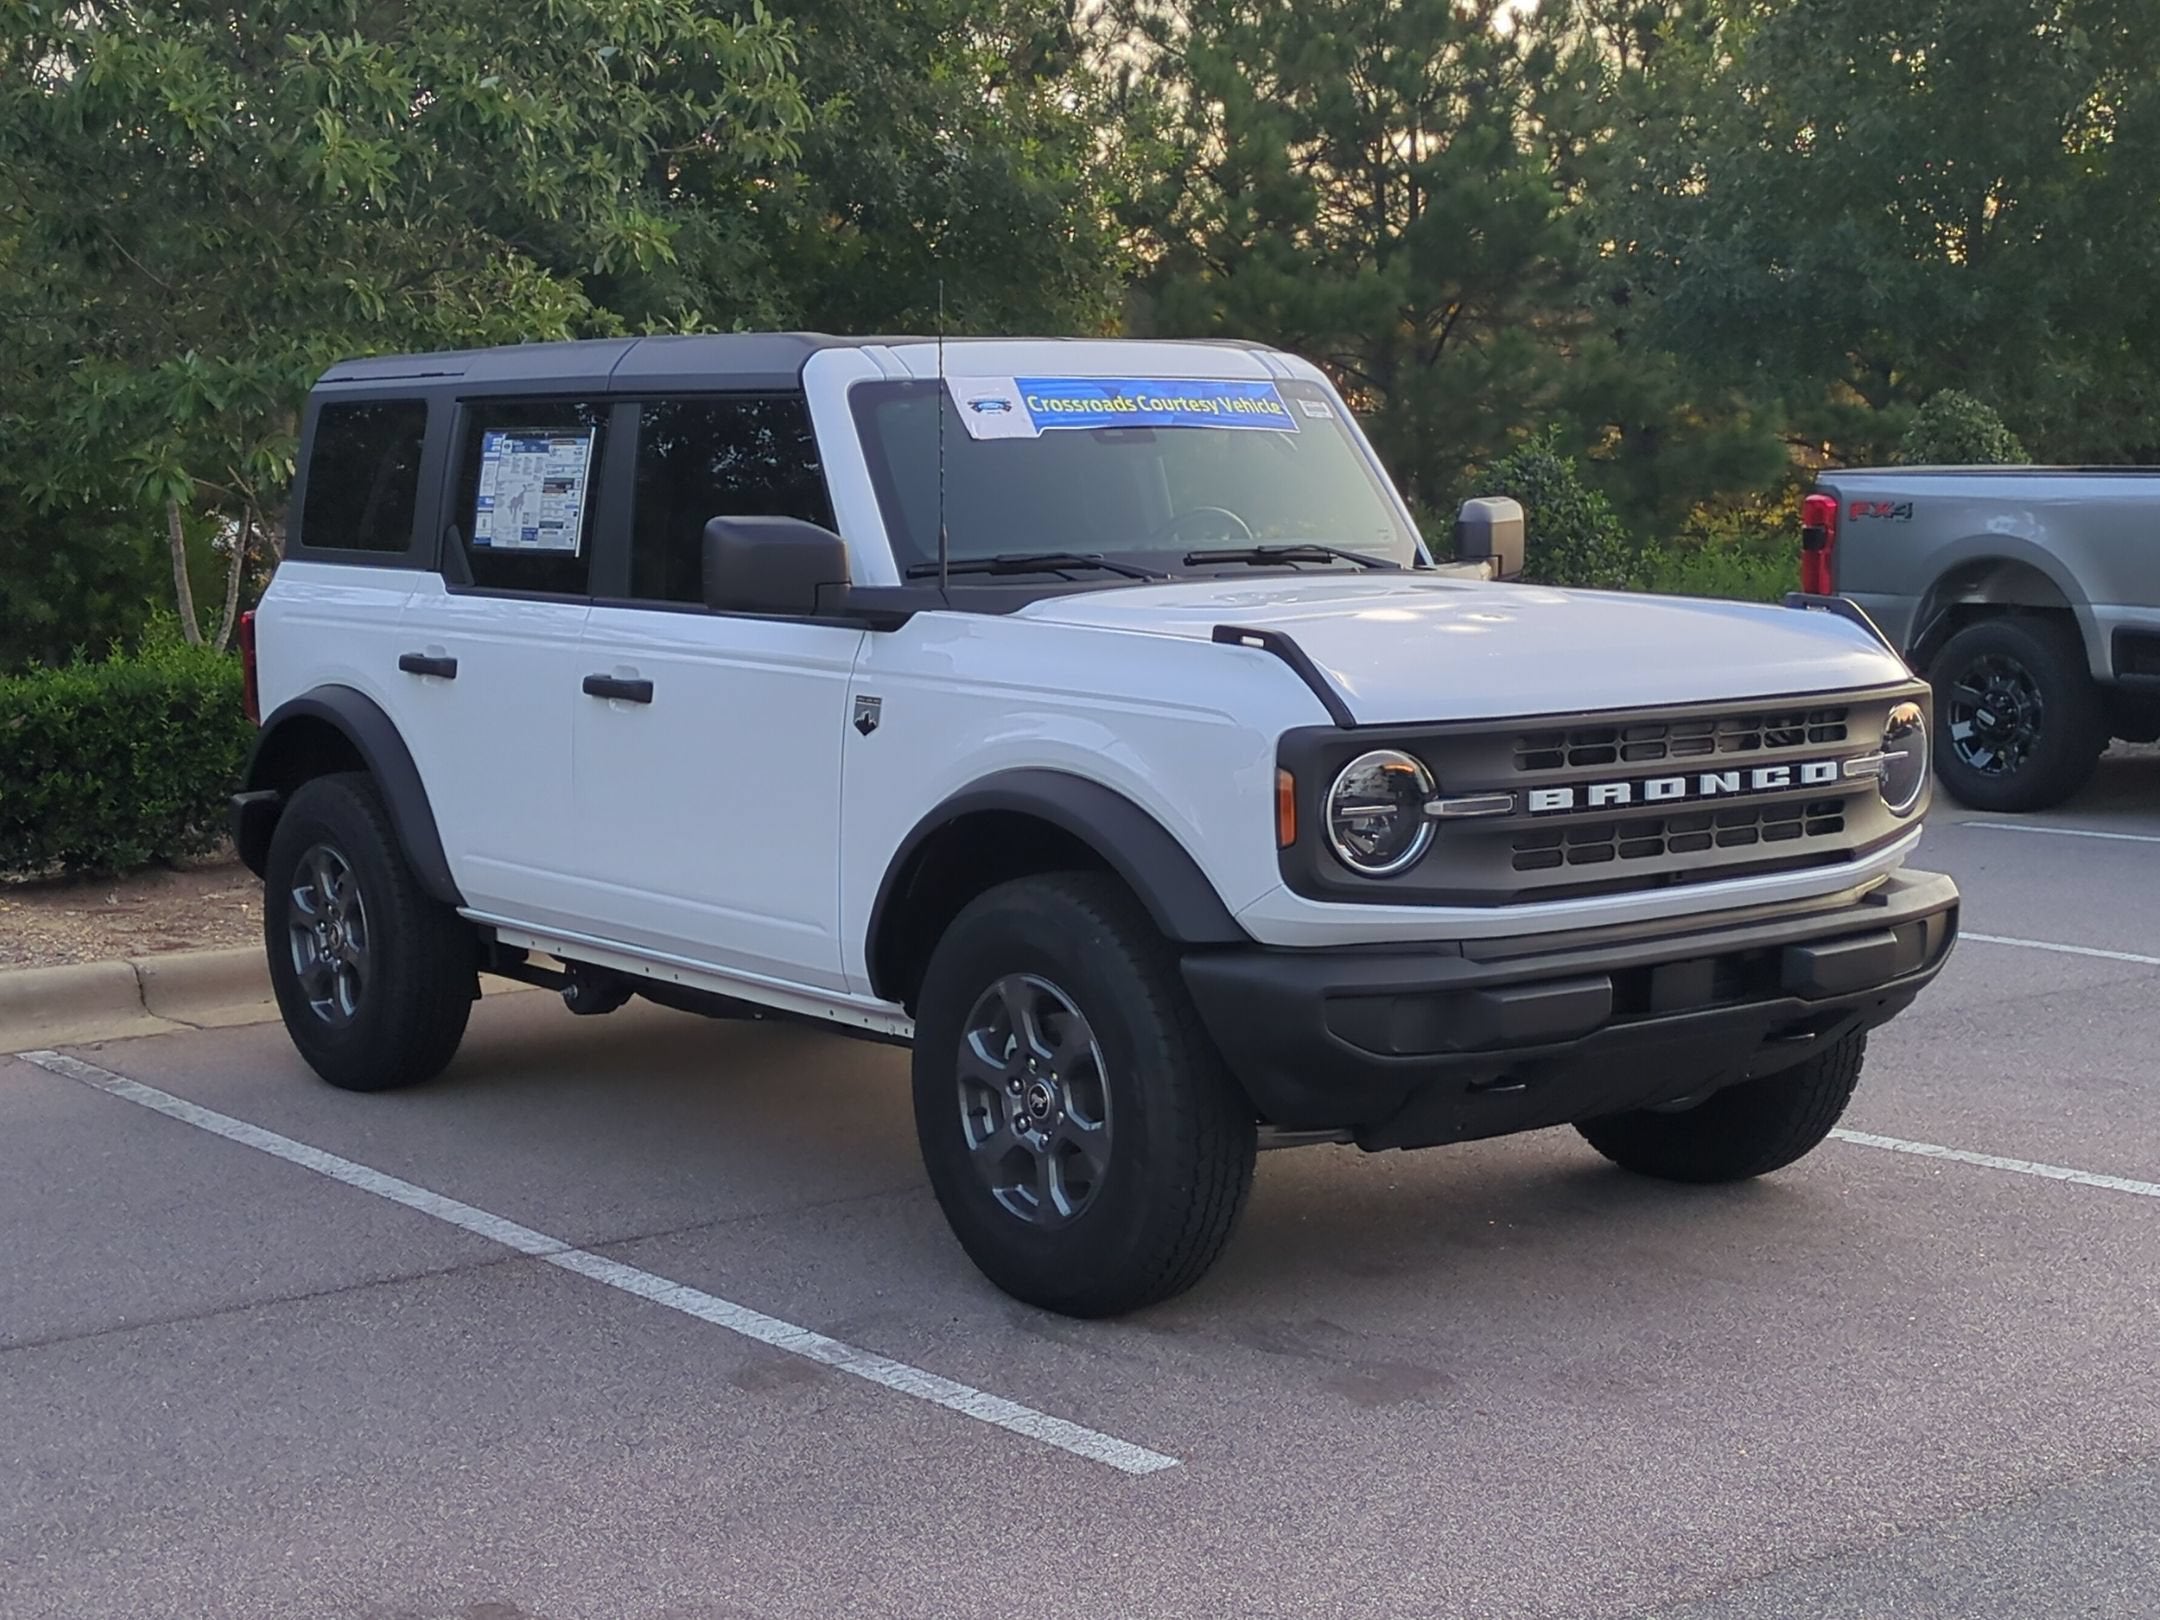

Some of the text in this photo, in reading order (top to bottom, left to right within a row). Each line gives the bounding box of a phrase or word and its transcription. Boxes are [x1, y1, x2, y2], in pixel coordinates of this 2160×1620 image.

[1027, 395, 1138, 413] Crossroads
[1136, 395, 1218, 415] Courtesy
[1217, 397, 1284, 415] Vehicle
[1849, 501, 1913, 521] FX4
[1529, 761, 1838, 811] BRONCO
